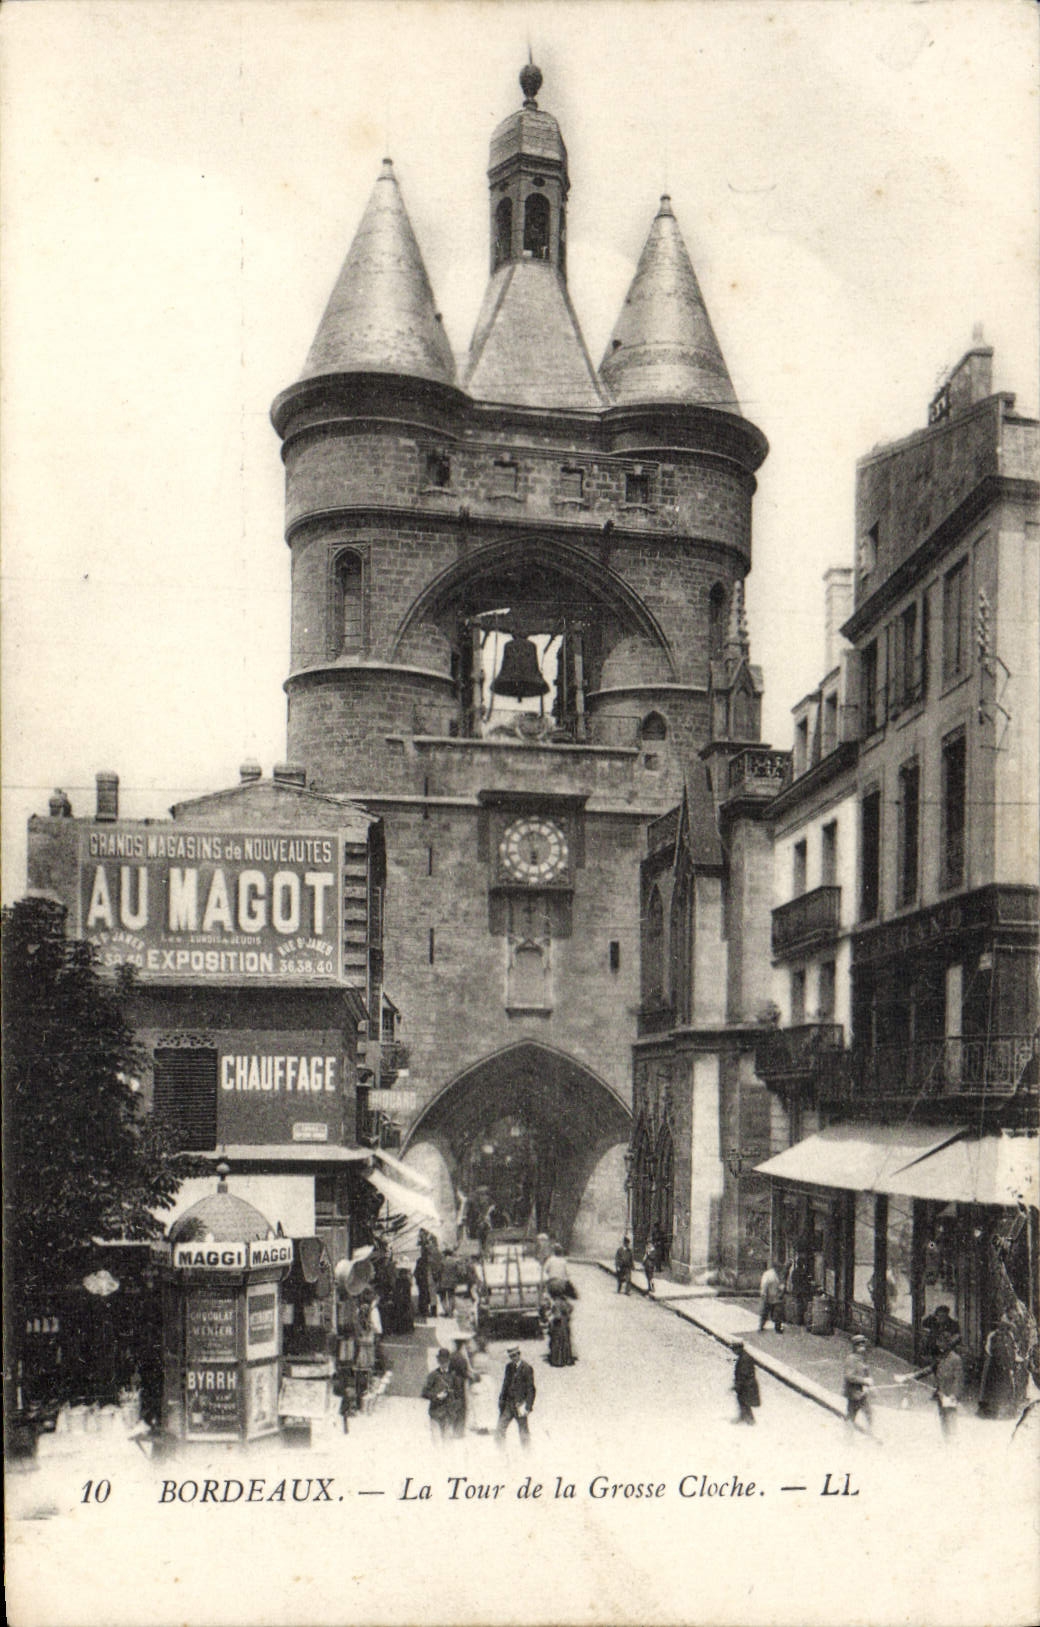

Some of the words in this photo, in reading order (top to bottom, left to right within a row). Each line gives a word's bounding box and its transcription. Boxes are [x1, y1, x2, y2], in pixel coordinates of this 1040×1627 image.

[89, 833, 144, 857] GRANDS
[147, 834, 222, 860] MAGASINS
[224, 842, 241, 861] de
[87, 865, 149, 930] AU
[168, 866, 335, 935] MAGOT
[147, 949, 274, 973] EXPOSITION
[220, 1055, 336, 1092] CHAUFFAGE
[178, 1251, 242, 1265] MAGGI
[252, 1248, 291, 1265] MAGGI
[187, 1371, 236, 1390] BYRRH
